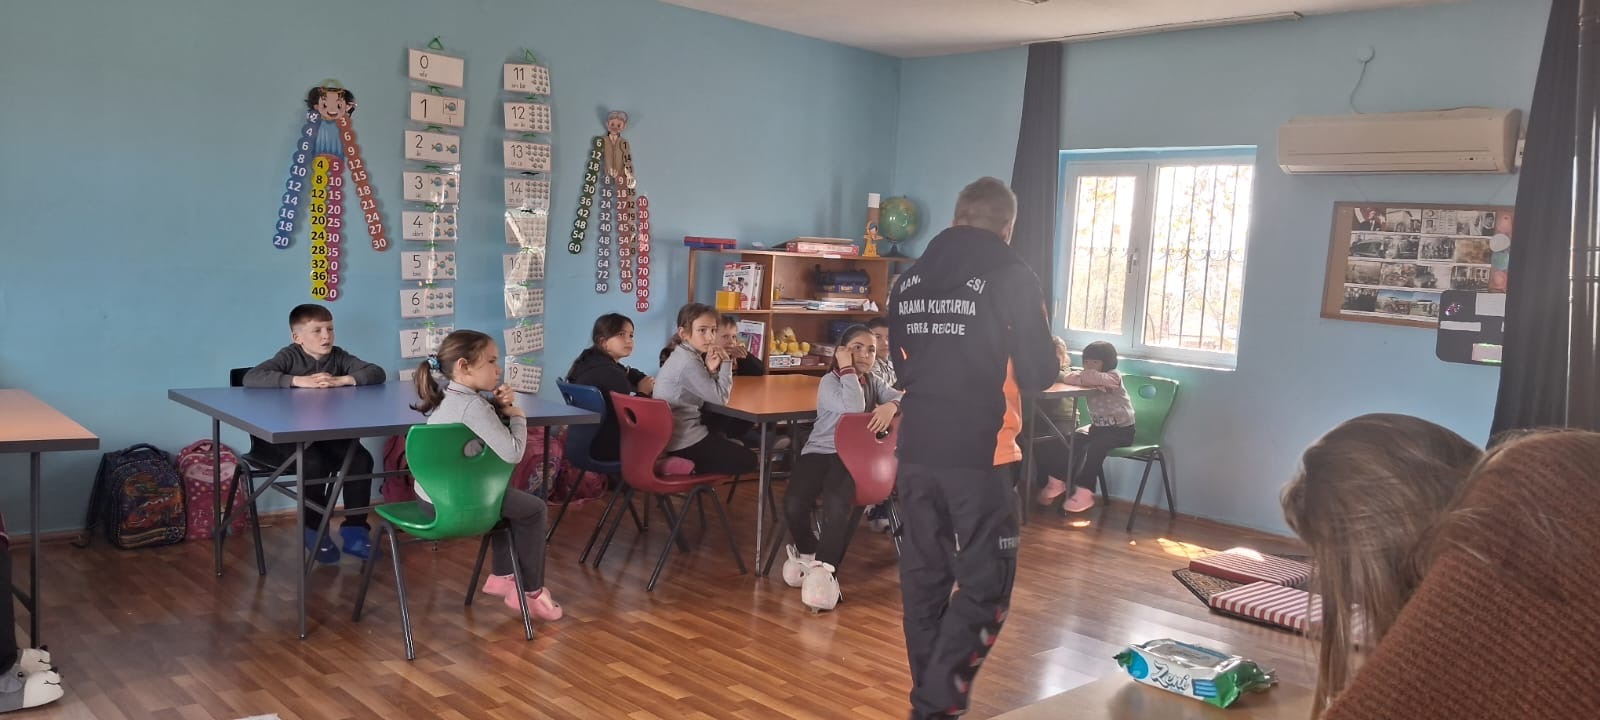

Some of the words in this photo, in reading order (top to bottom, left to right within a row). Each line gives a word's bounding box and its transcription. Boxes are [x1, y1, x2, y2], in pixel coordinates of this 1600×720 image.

[512, 67, 524, 80] 11
[420, 98, 427, 118] 1
[512, 106, 525, 120] 12
[341, 118, 347, 126] 3
[306, 128, 312, 136] 4
[344, 132, 352, 141] 6
[302, 142, 308, 150] 6
[415, 134, 424, 149] 2
[596, 138, 602, 147] 6
[348, 146, 354, 156] 9
[510, 144, 523, 158] 13
[592, 150, 602, 160] 12
[297, 154, 304, 164] 8
[317, 160, 324, 168] 4
[333, 162, 340, 170] 5
[348, 158, 362, 170] 12
[588, 162, 600, 171] 18
[292, 166, 306, 176] 10
[316, 176, 322, 184] 8
[354, 170, 366, 182] 15
[586, 174, 596, 183] 24
[604, 176, 610, 184] 8
[618, 176, 624, 184] 9
[288, 180, 302, 192] 12
[330, 177, 342, 186] 10
[414, 176, 424, 190] 3
[312, 189, 324, 198] 12
[357, 186, 371, 196] 18
[510, 182, 523, 196] 14
[584, 184, 595, 194] 30
[602, 189, 612, 198] 16
[328, 192, 341, 200] 15
[616, 190, 627, 198] 18
[284, 194, 298, 206] 14
[580, 196, 592, 206] 36
[600, 200, 611, 208] 24
[638, 198, 648, 206] 10
[310, 204, 324, 213] 16
[362, 200, 376, 210] 21
[616, 201, 627, 209] 27
[280, 208, 294, 220] 16
[328, 206, 341, 214] 20
[578, 208, 589, 218] 42
[638, 210, 648, 218] 20
[312, 216, 325, 224] 20
[366, 212, 380, 223] 24
[600, 213, 610, 221] 32
[617, 213, 628, 222] 36
[278, 221, 293, 232] 18
[328, 218, 341, 228] 25
[412, 216, 423, 228] 4
[574, 220, 586, 230] 48
[369, 224, 382, 235] 27
[600, 224, 611, 232] 40
[618, 224, 629, 232] 45
[311, 232, 324, 240] 24
[326, 233, 340, 242] 30
[572, 230, 584, 240] 54
[274, 236, 288, 246] 20
[372, 238, 386, 250] 30
[598, 236, 610, 245] 48
[618, 236, 629, 244] 54
[312, 246, 326, 254] 28
[568, 242, 580, 252] 60
[598, 248, 610, 256] 56
[620, 248, 630, 256] 63
[312, 260, 326, 268] 32
[412, 254, 422, 268] 5
[598, 260, 609, 268] 64
[638, 256, 648, 264] 60
[312, 272, 326, 280] 36
[598, 271, 609, 279] 72
[638, 268, 648, 276] 70
[596, 283, 608, 292] 80
[621, 282, 632, 290] 90
[638, 279, 648, 287] 80
[312, 286, 326, 296] 40
[412, 292, 420, 306] 6
[898, 299, 926, 316] ARAMA
[411, 331, 419, 346] 7
[512, 330, 522, 344] 18
[509, 366, 518, 380] 19
[1151, 660, 1190, 692] Zeni
